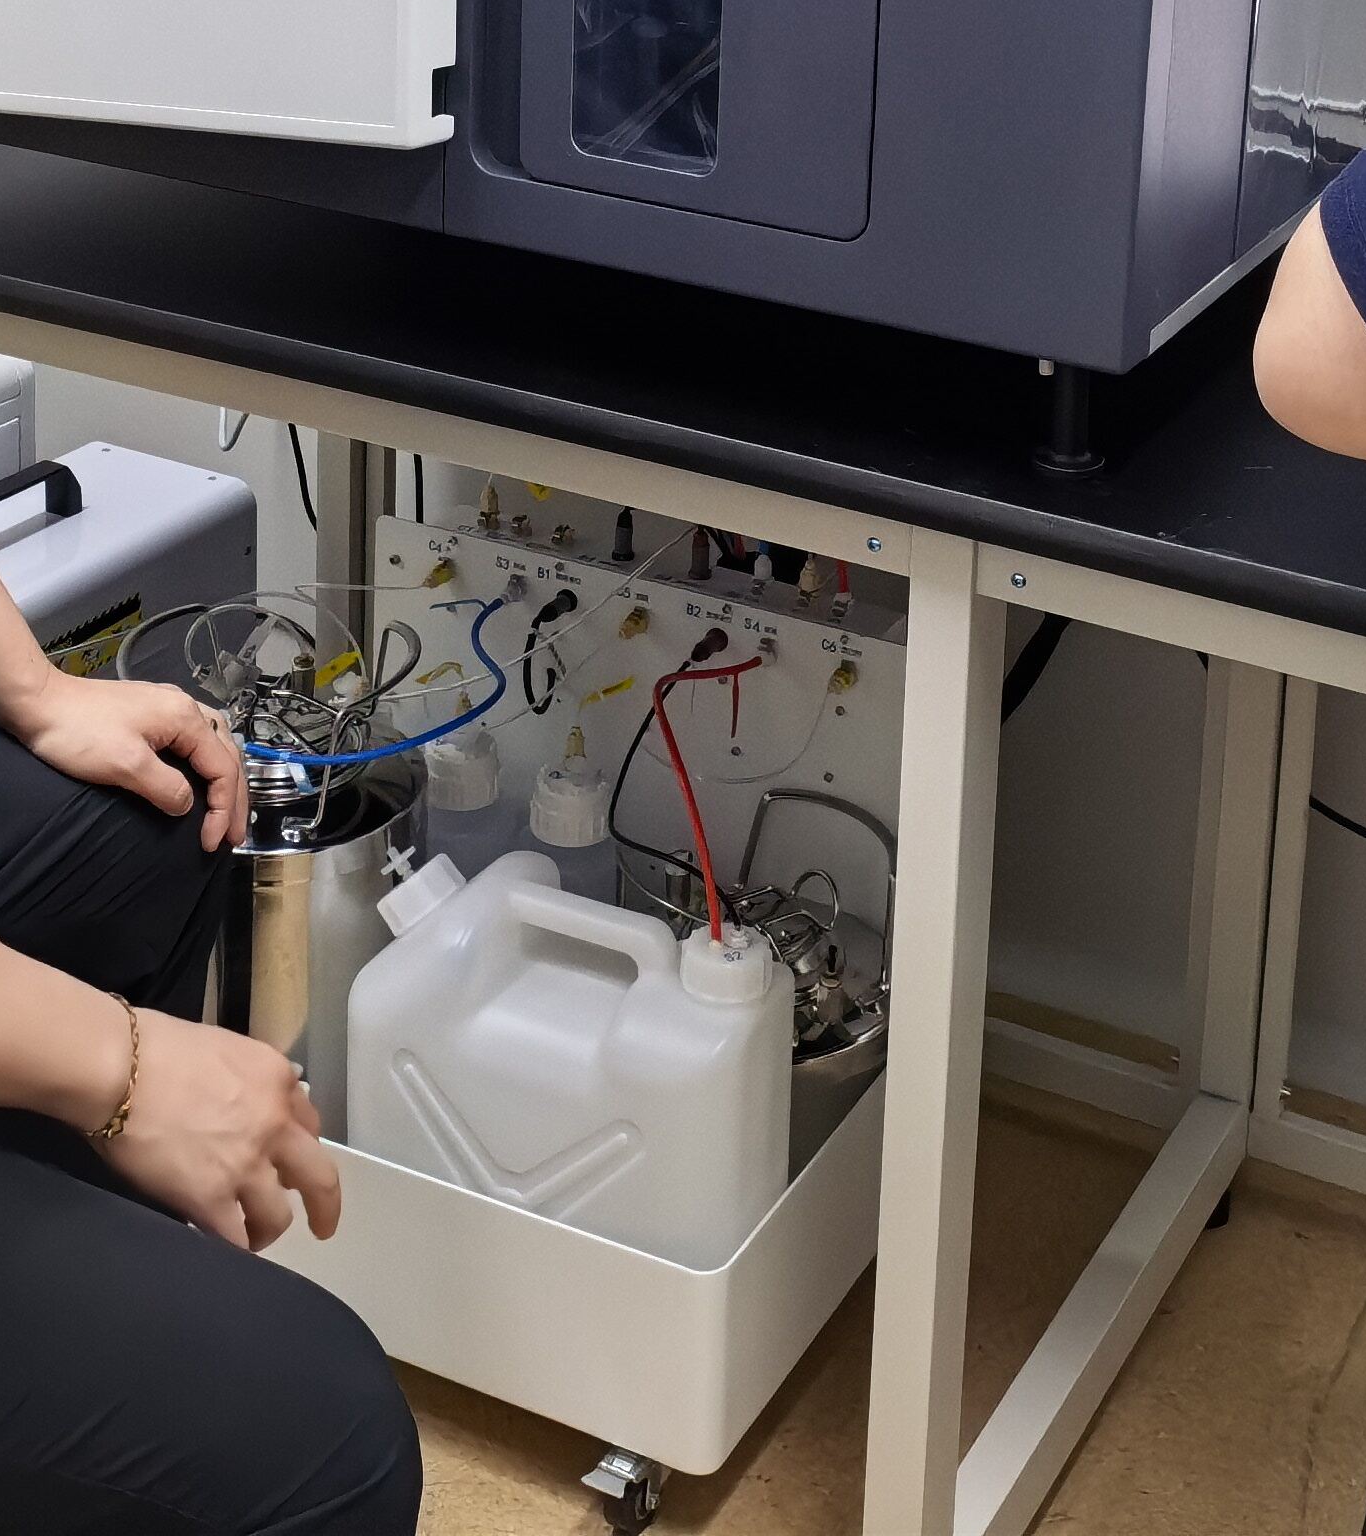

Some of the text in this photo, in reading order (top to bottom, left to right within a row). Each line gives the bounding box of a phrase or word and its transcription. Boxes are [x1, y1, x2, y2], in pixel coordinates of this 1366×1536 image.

[537, 566, 550, 580] B1
[686, 603, 701, 617] B2
[744, 617, 760, 633] S4
